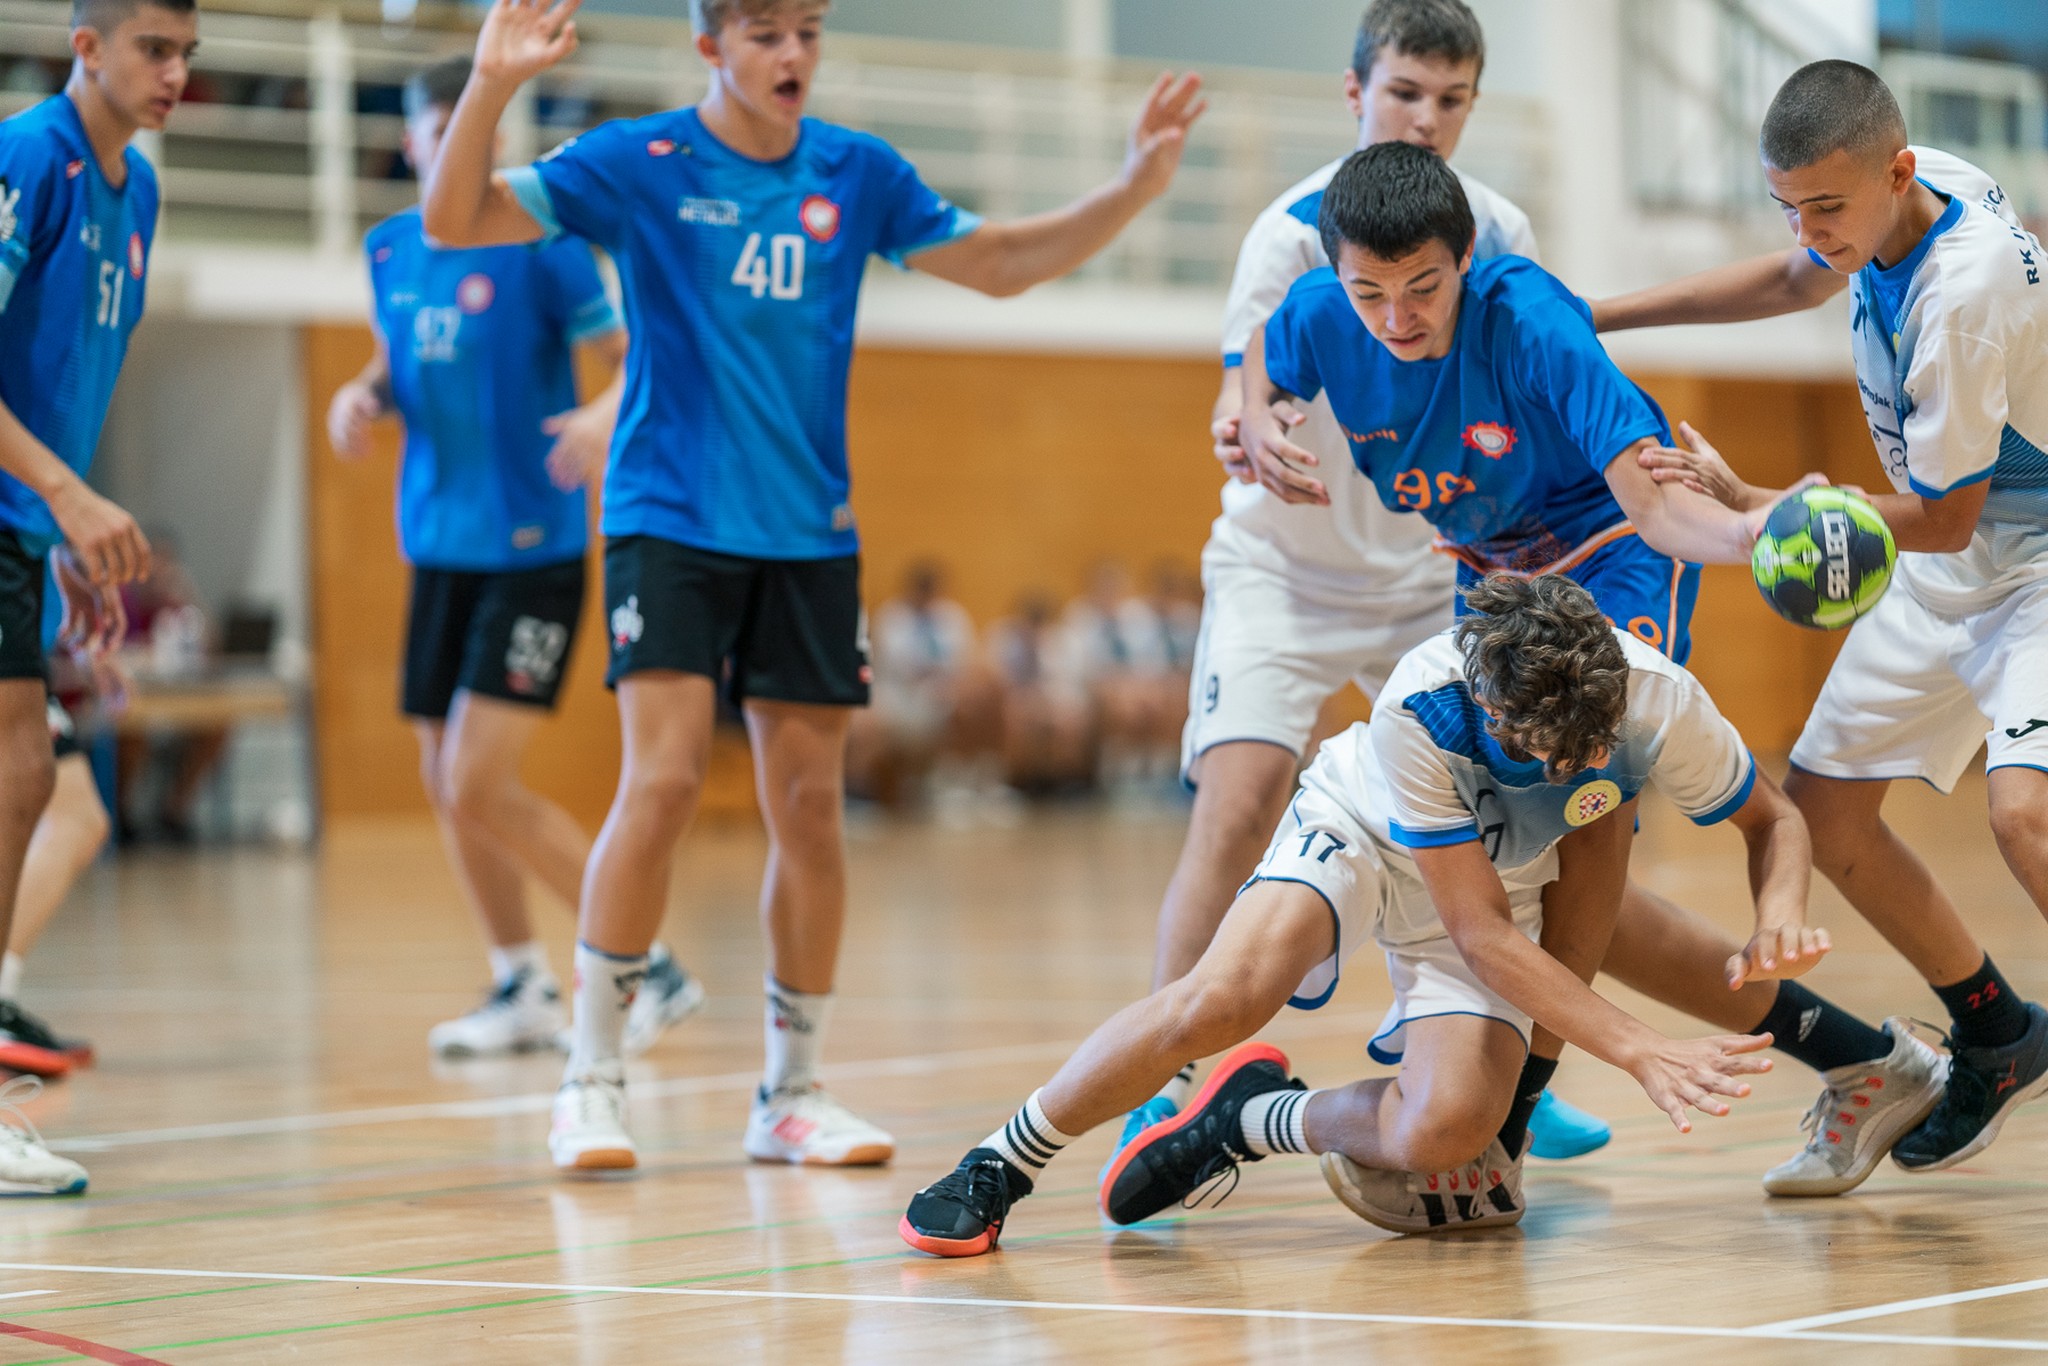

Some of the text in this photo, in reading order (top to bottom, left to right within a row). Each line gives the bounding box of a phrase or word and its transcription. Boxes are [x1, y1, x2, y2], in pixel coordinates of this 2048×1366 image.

[731, 232, 806, 300] 40
[2019, 248, 2040, 285] RK
[97, 259, 125, 330] 51
[1394, 468, 1476, 510] 98
[1821, 511, 1850, 600] SELECT
[1206, 674, 1219, 714] 9
[1299, 830, 1347, 864] 17
